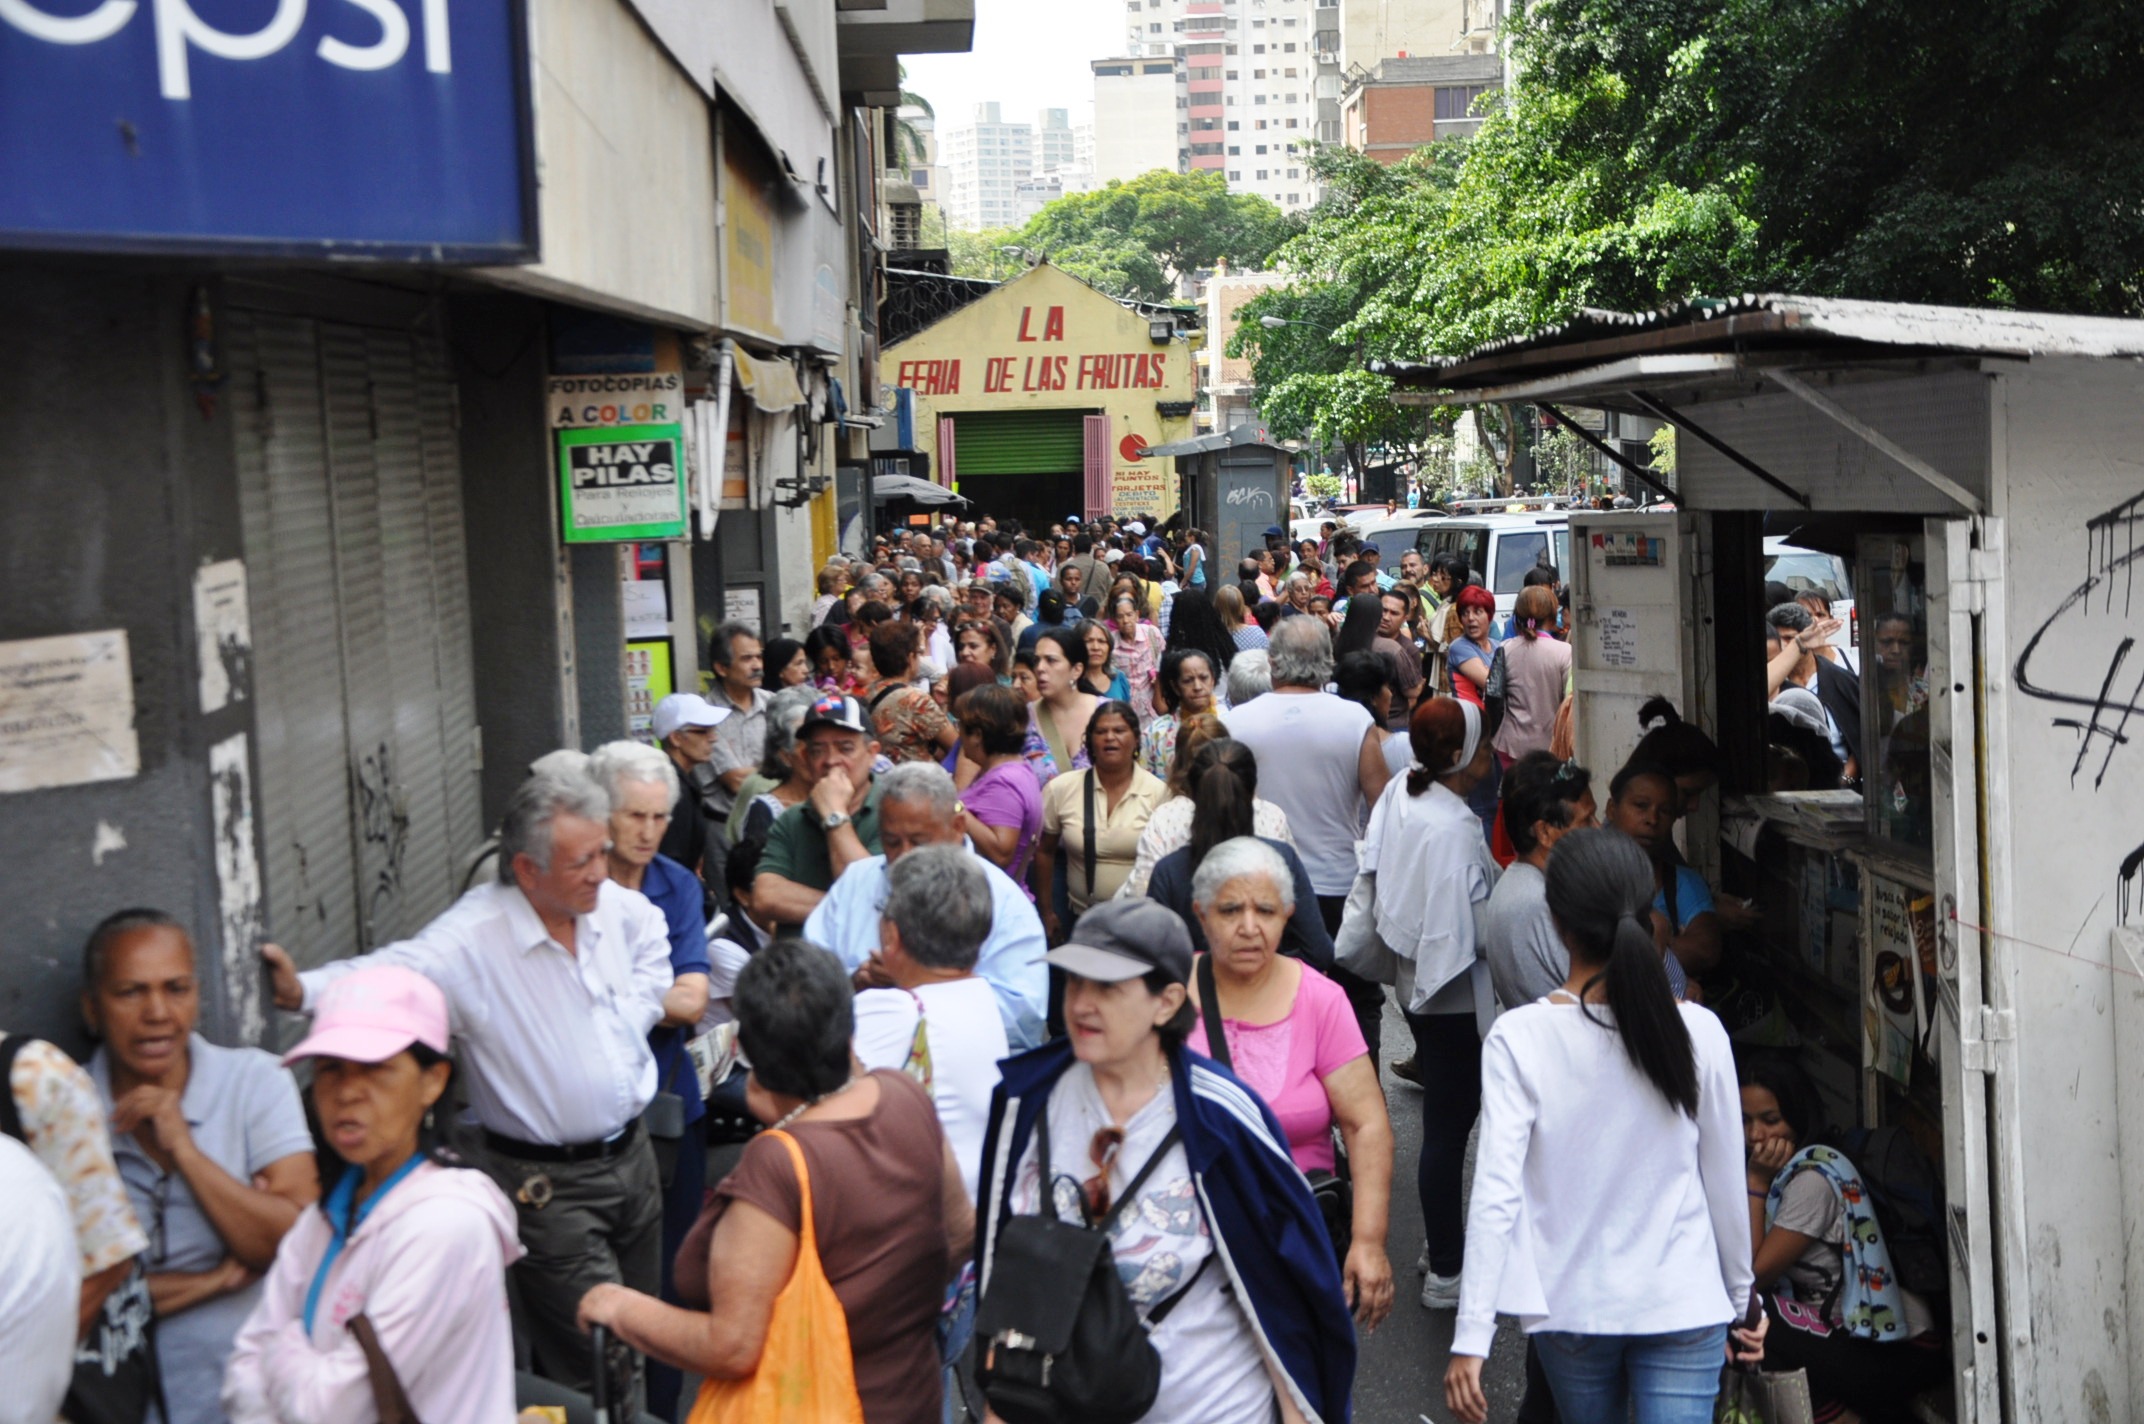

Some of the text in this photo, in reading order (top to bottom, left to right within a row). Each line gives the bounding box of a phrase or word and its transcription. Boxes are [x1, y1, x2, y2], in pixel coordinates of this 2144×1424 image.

[1017, 306, 1064, 342] LA
[551, 376, 679, 393] FOTOCOPIAS
[898, 359, 961, 396] FERIA
[984, 357, 1017, 393] DE
[1022, 356, 1068, 392] LAS
[558, 404, 667, 423] A COLOR
[588, 445, 655, 465] HAY
[574, 463, 674, 486] PILAS
[576, 487, 612, 500] Para
